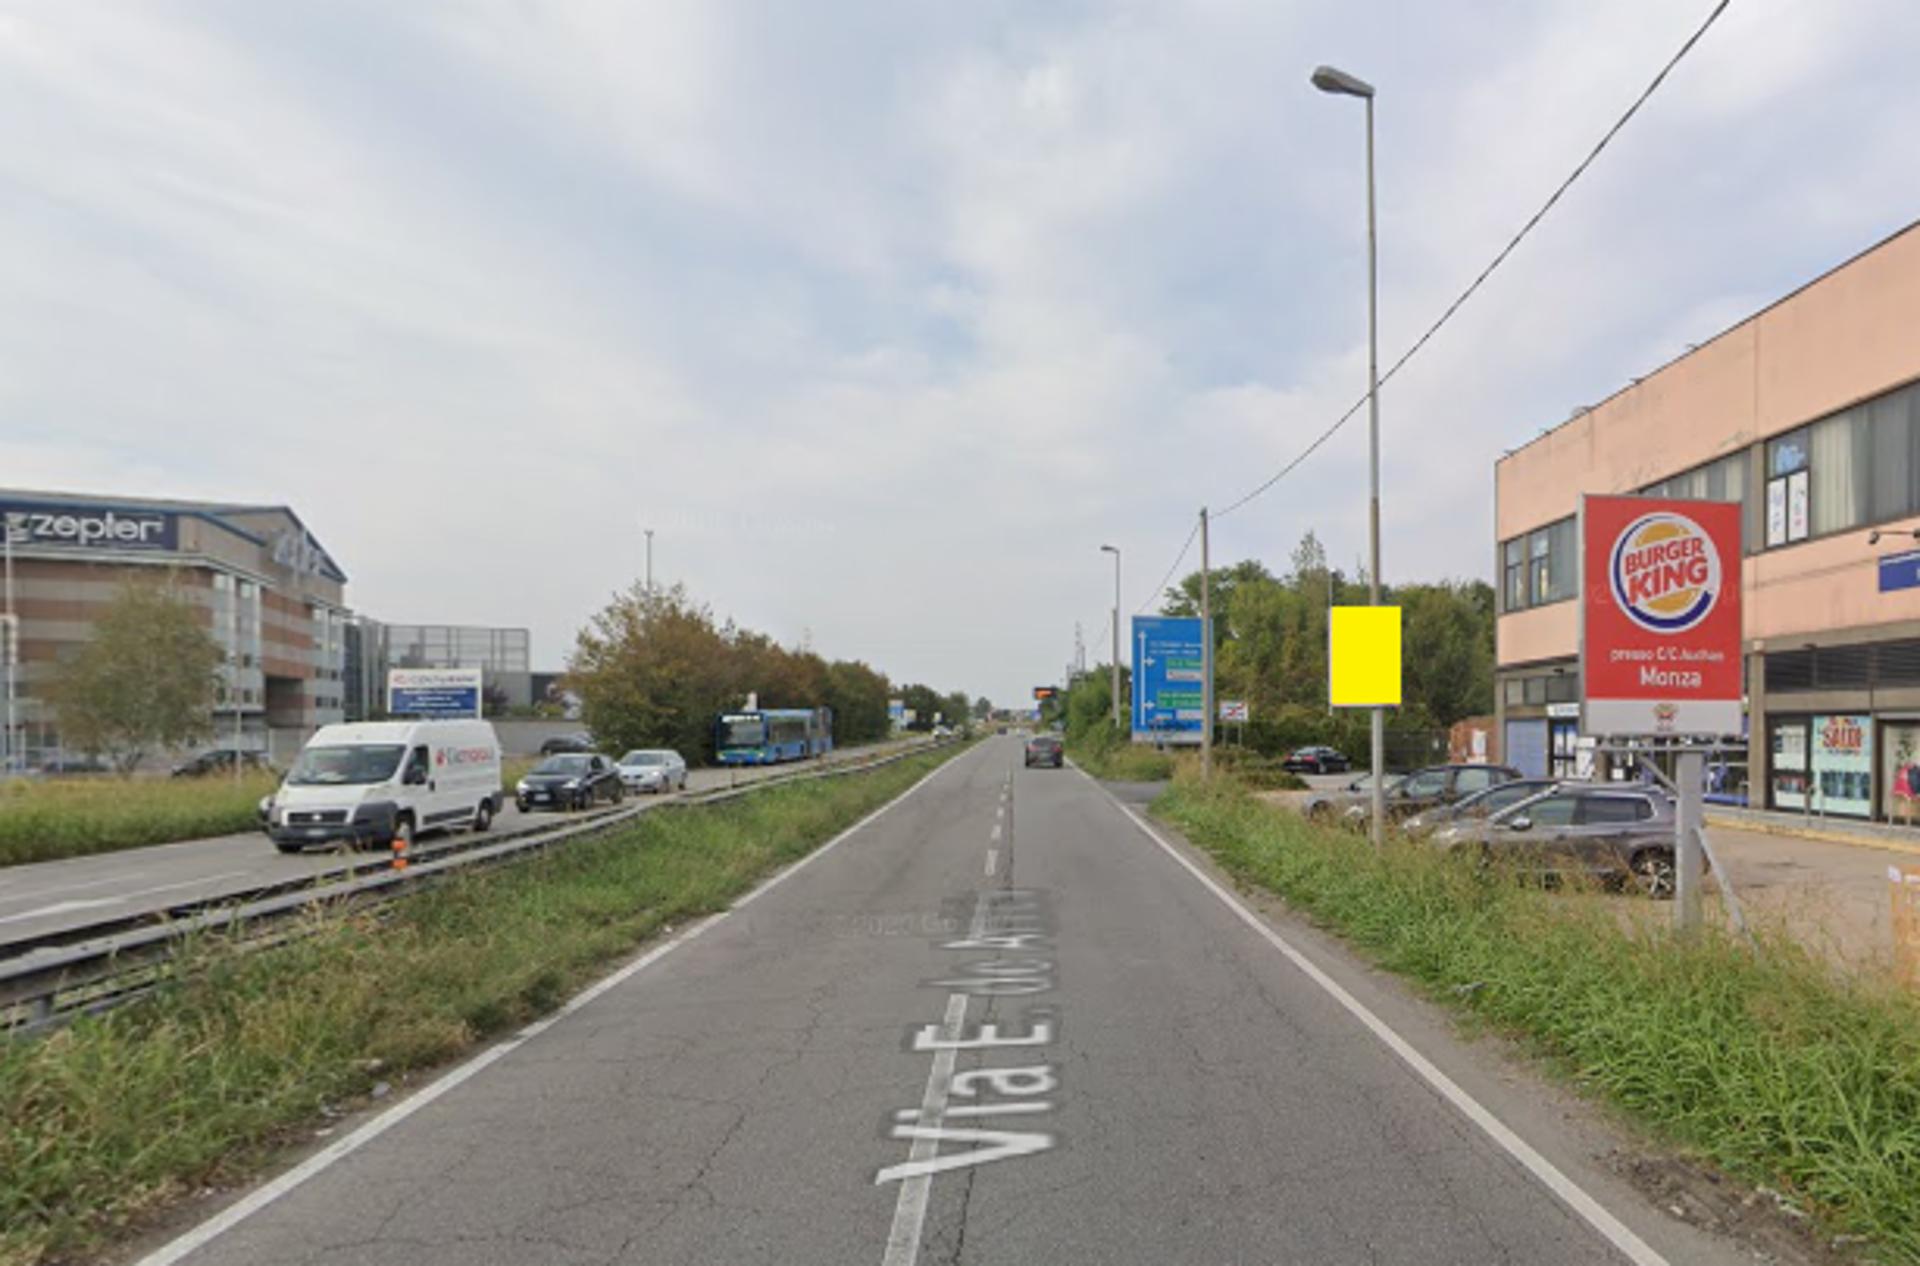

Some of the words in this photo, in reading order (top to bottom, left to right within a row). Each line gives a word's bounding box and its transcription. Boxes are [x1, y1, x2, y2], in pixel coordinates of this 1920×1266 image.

[1624, 537, 1704, 575] BURGER
[1628, 557, 1708, 605] KING
[1640, 666, 1702, 688] Monza
